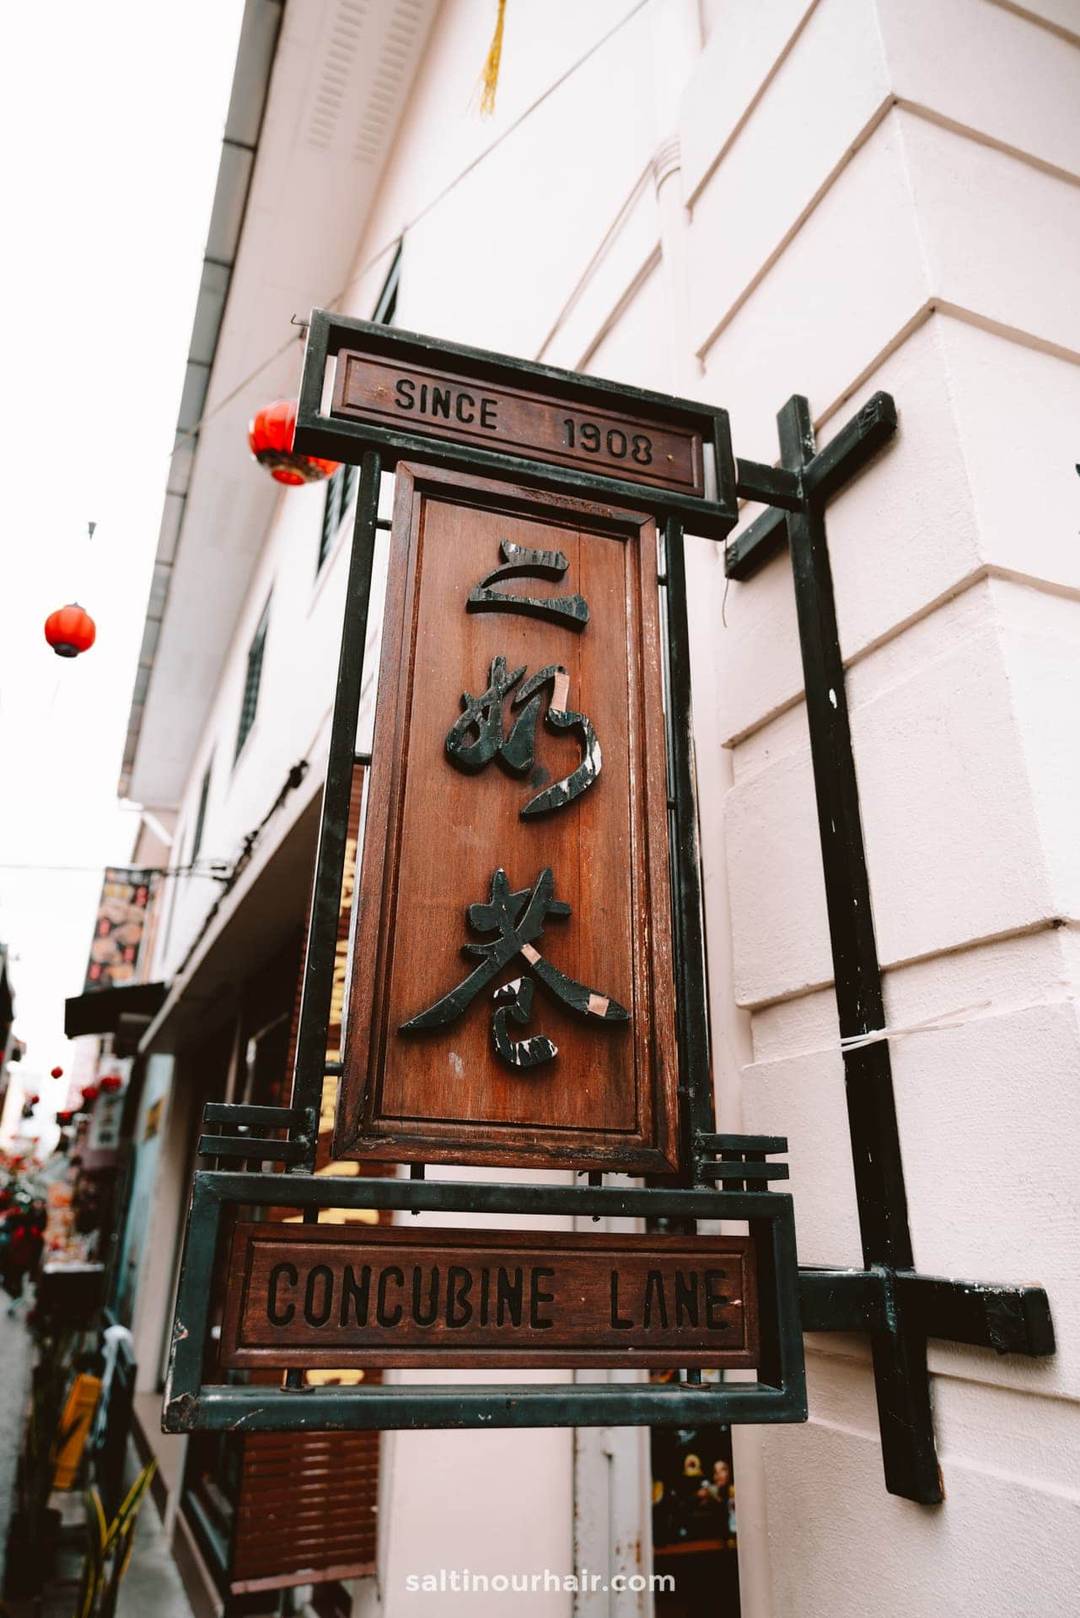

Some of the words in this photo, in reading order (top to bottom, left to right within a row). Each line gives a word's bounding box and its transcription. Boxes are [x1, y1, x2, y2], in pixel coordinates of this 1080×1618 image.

[394, 378, 499, 431] SINCE
[563, 417, 654, 467] 1908
[266, 1261, 556, 1330] CONCUBINE
[610, 1268, 731, 1331] LANE
